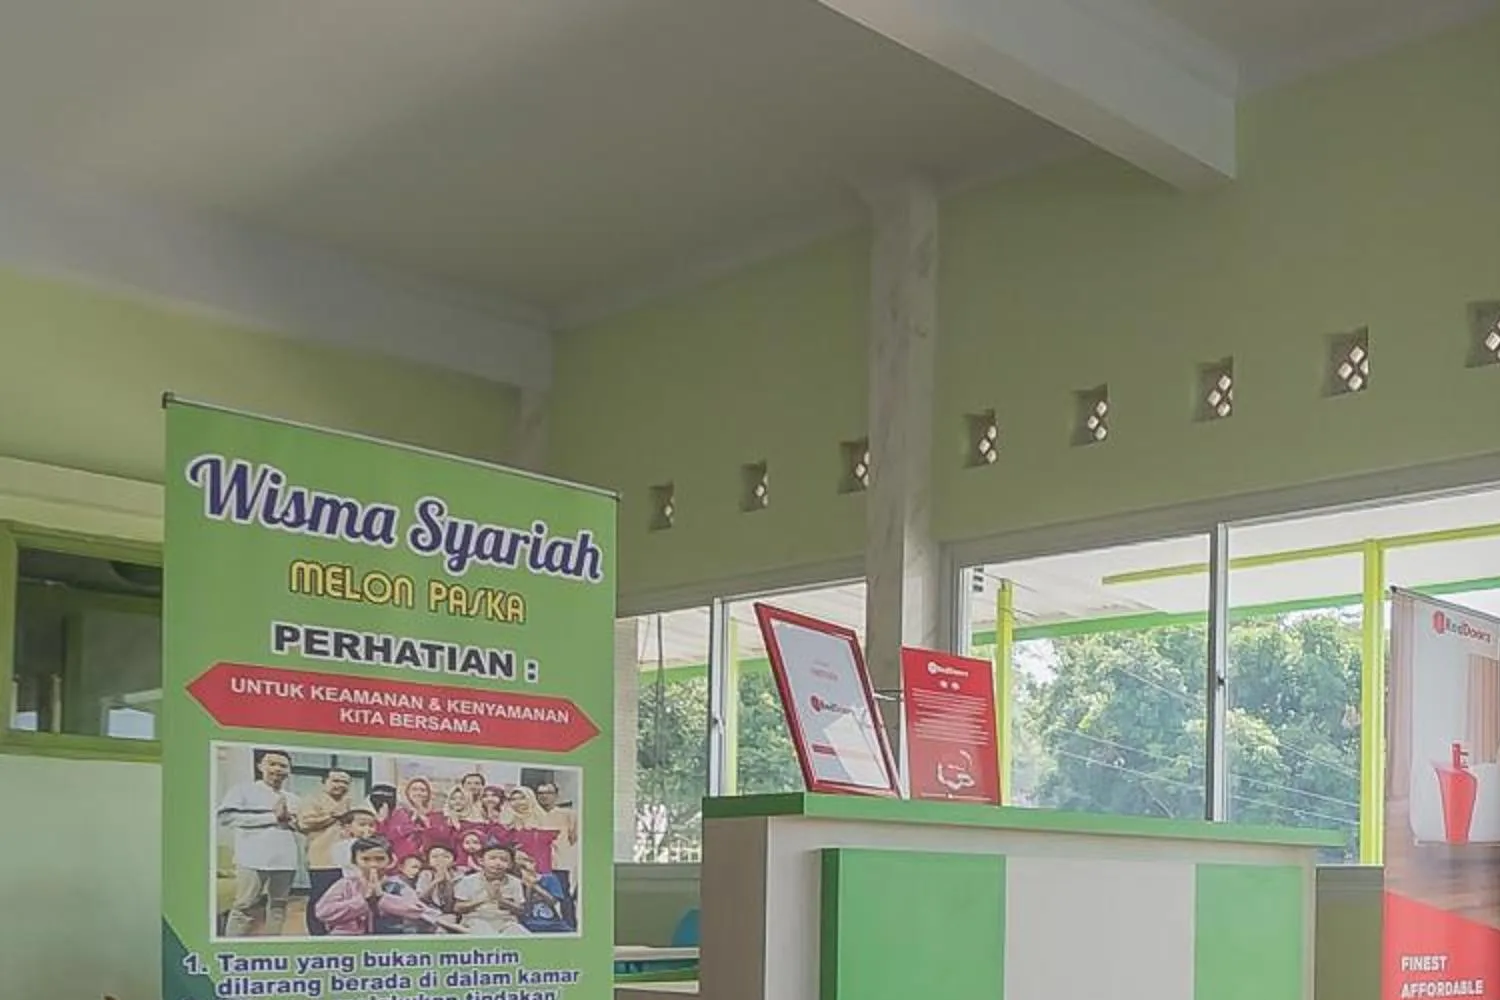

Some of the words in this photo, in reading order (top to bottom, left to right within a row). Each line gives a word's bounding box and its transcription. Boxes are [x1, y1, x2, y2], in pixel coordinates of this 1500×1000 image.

[188, 454, 398, 546] Wisma
[408, 497, 603, 581] Syariah
[290, 560, 414, 607] MELON
[429, 580, 526, 624] PASKA
[273, 622, 514, 680] PERHATIAN
[231, 677, 304, 700] UNTUK
[310, 684, 423, 710] KEAMANAN
[428, 697, 441, 711] &
[447, 699, 570, 724] KENYAMANAN
[340, 708, 385, 727] KITA
[389, 712, 481, 734] BERSAMA
[183, 954, 208, 974] 1.
[218, 954, 288, 972] Tamu
[297, 956, 355, 974] yang
[363, 951, 431, 967] bukan
[440, 950, 519, 966] muhrim
[1401, 955, 1448, 972] FINEST
[218, 977, 321, 996] dilarang
[331, 974, 411, 991] berada
[419, 972, 437, 987] di
[446, 970, 511, 987] dalam
[518, 969, 579, 984] kamar
[1401, 979, 1485, 998] AFFORDABLE
